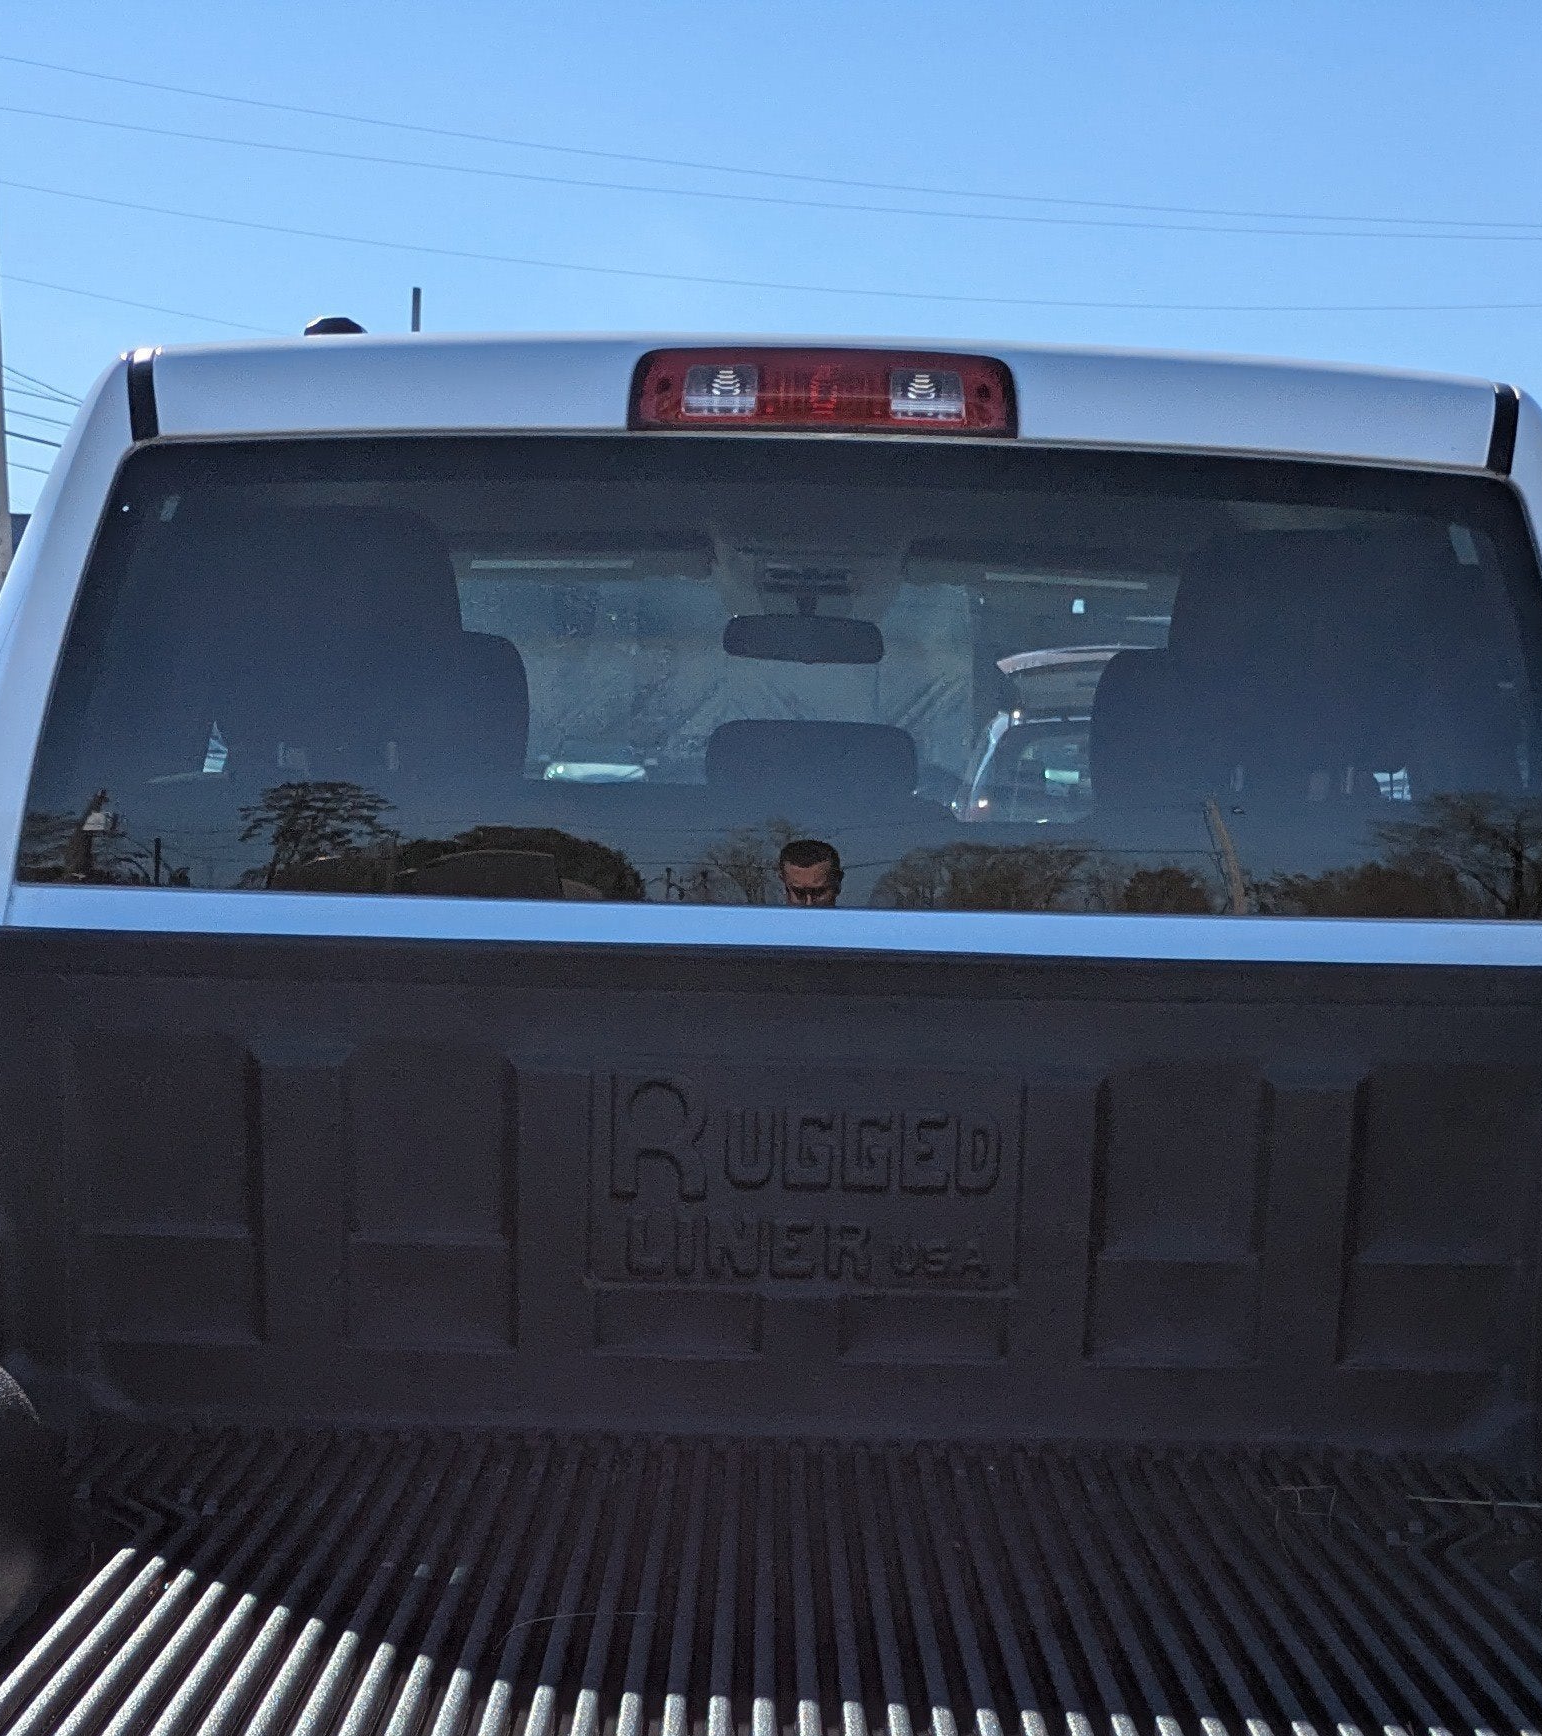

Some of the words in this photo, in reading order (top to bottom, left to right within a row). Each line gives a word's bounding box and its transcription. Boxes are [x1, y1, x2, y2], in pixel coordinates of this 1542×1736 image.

[610, 1075, 1003, 1202] RUGGED
[624, 1208, 873, 1280] LINER
[888, 1235, 991, 1280] USA
